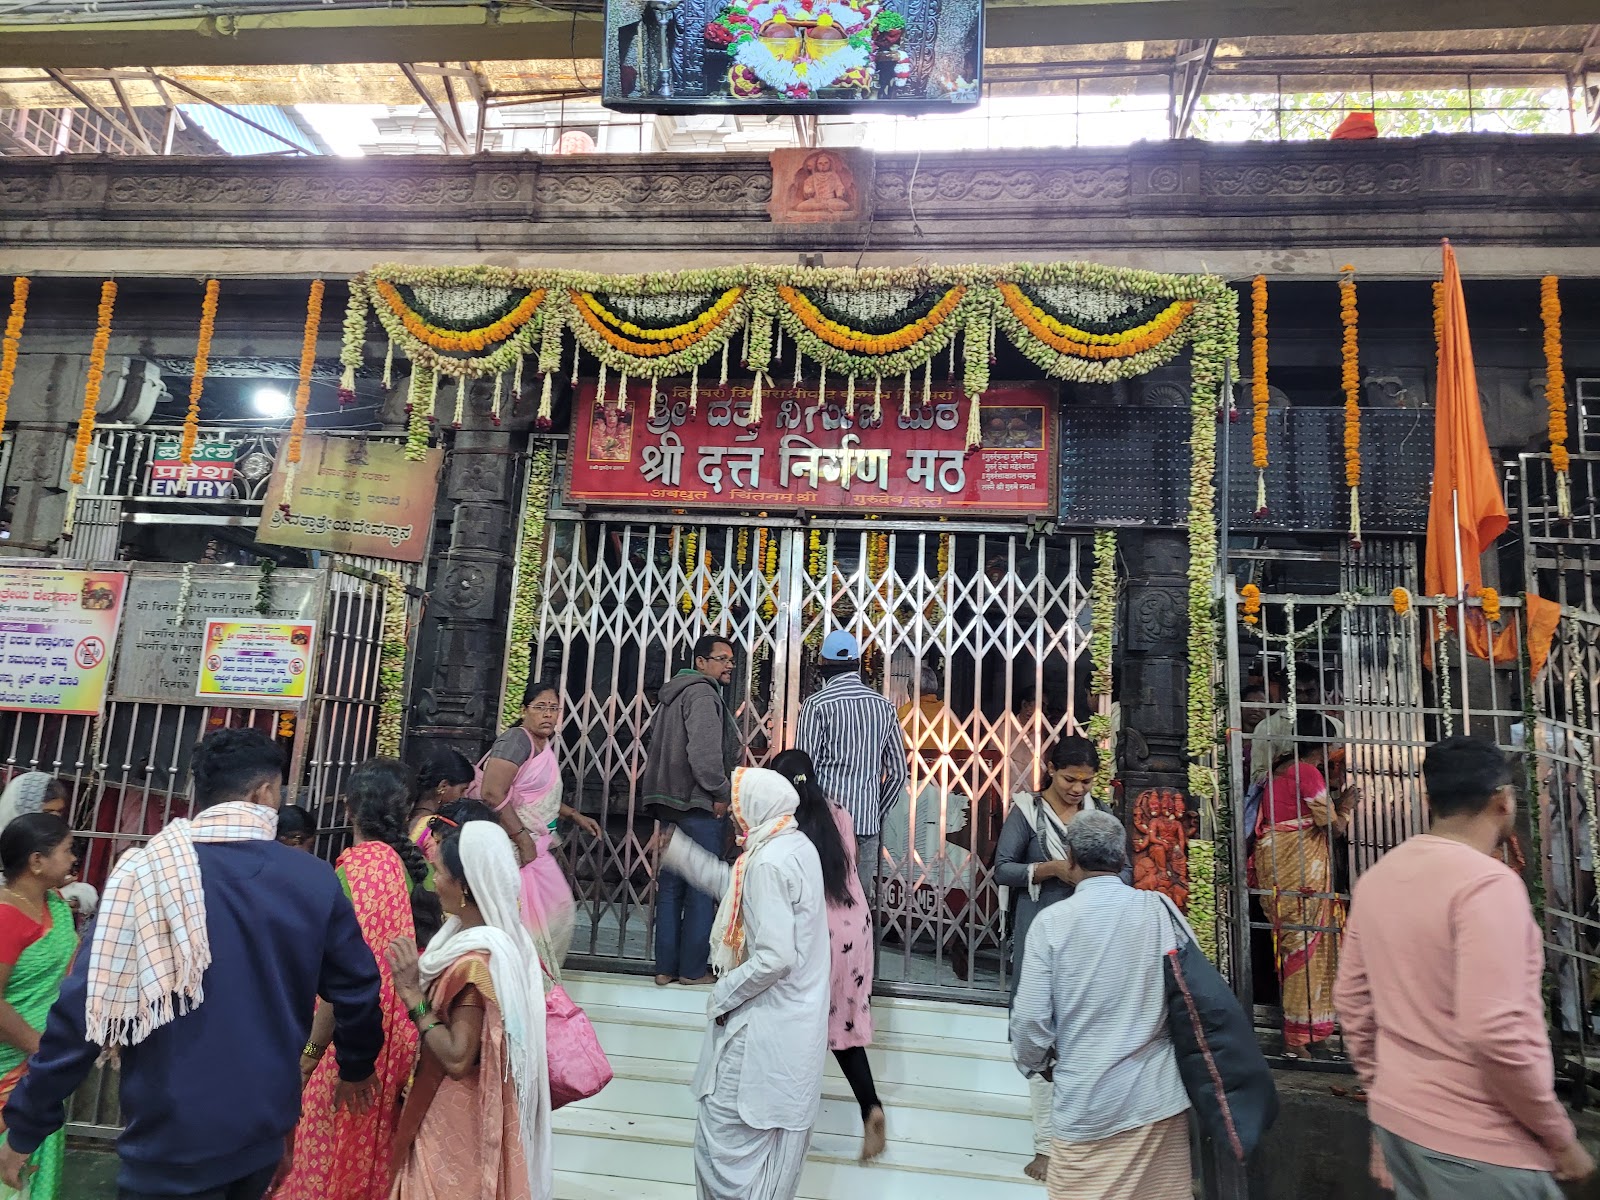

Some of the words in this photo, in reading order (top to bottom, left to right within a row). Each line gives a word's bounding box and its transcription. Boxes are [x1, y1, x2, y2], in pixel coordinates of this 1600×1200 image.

[639, 431, 685, 487] श्री
[698, 445, 765, 494] दत्त
[906, 449, 967, 493] मठ
[150, 480, 231, 497] ENTRY
[795, 491, 818, 502] श्री
